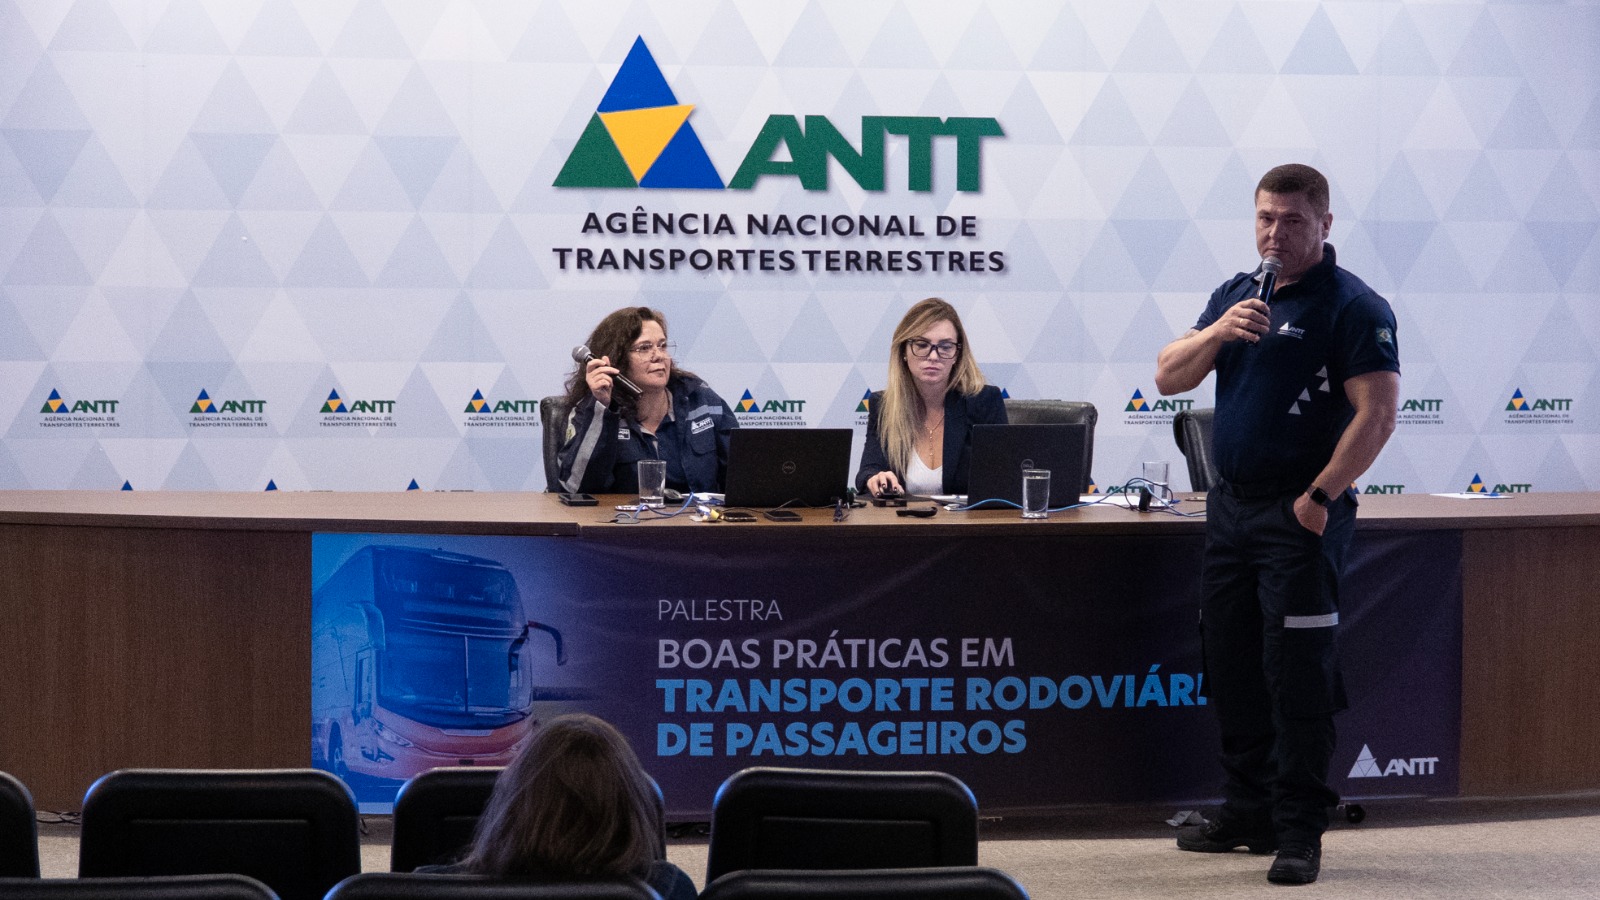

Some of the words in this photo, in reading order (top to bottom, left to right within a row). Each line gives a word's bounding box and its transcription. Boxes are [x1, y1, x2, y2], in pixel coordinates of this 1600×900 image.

[727, 114, 1005, 192] ANTT
[581, 206, 736, 236] AGÊNCIA
[747, 213, 924, 237] NACIONAL
[937, 215, 977, 237] DE
[553, 248, 795, 271] TRANSPORTES
[802, 250, 1005, 272] TERRESTRES
[70, 400, 119, 413] ANTT
[219, 400, 267, 413] ANTT
[349, 400, 396, 413] ANTT
[492, 400, 538, 413] ANTT
[761, 400, 806, 412] ANTT
[1151, 399, 1195, 411] ANTT
[1402, 399, 1443, 411] ANTT
[1532, 398, 1573, 411] ANTT
[1364, 485, 1405, 494] ANTT
[1492, 484, 1532, 493] ANTT
[658, 599, 783, 621] PALESTRA
[658, 638, 761, 669] BOAS
[773, 630, 949, 669] PRÁTICAS
[961, 638, 1015, 667] EM
[656, 677, 954, 713] TRANSPORTE
[657, 722, 713, 757] DE
[726, 720, 1026, 756] PASSAGEIROS
[1383, 757, 1439, 776] ANTT
